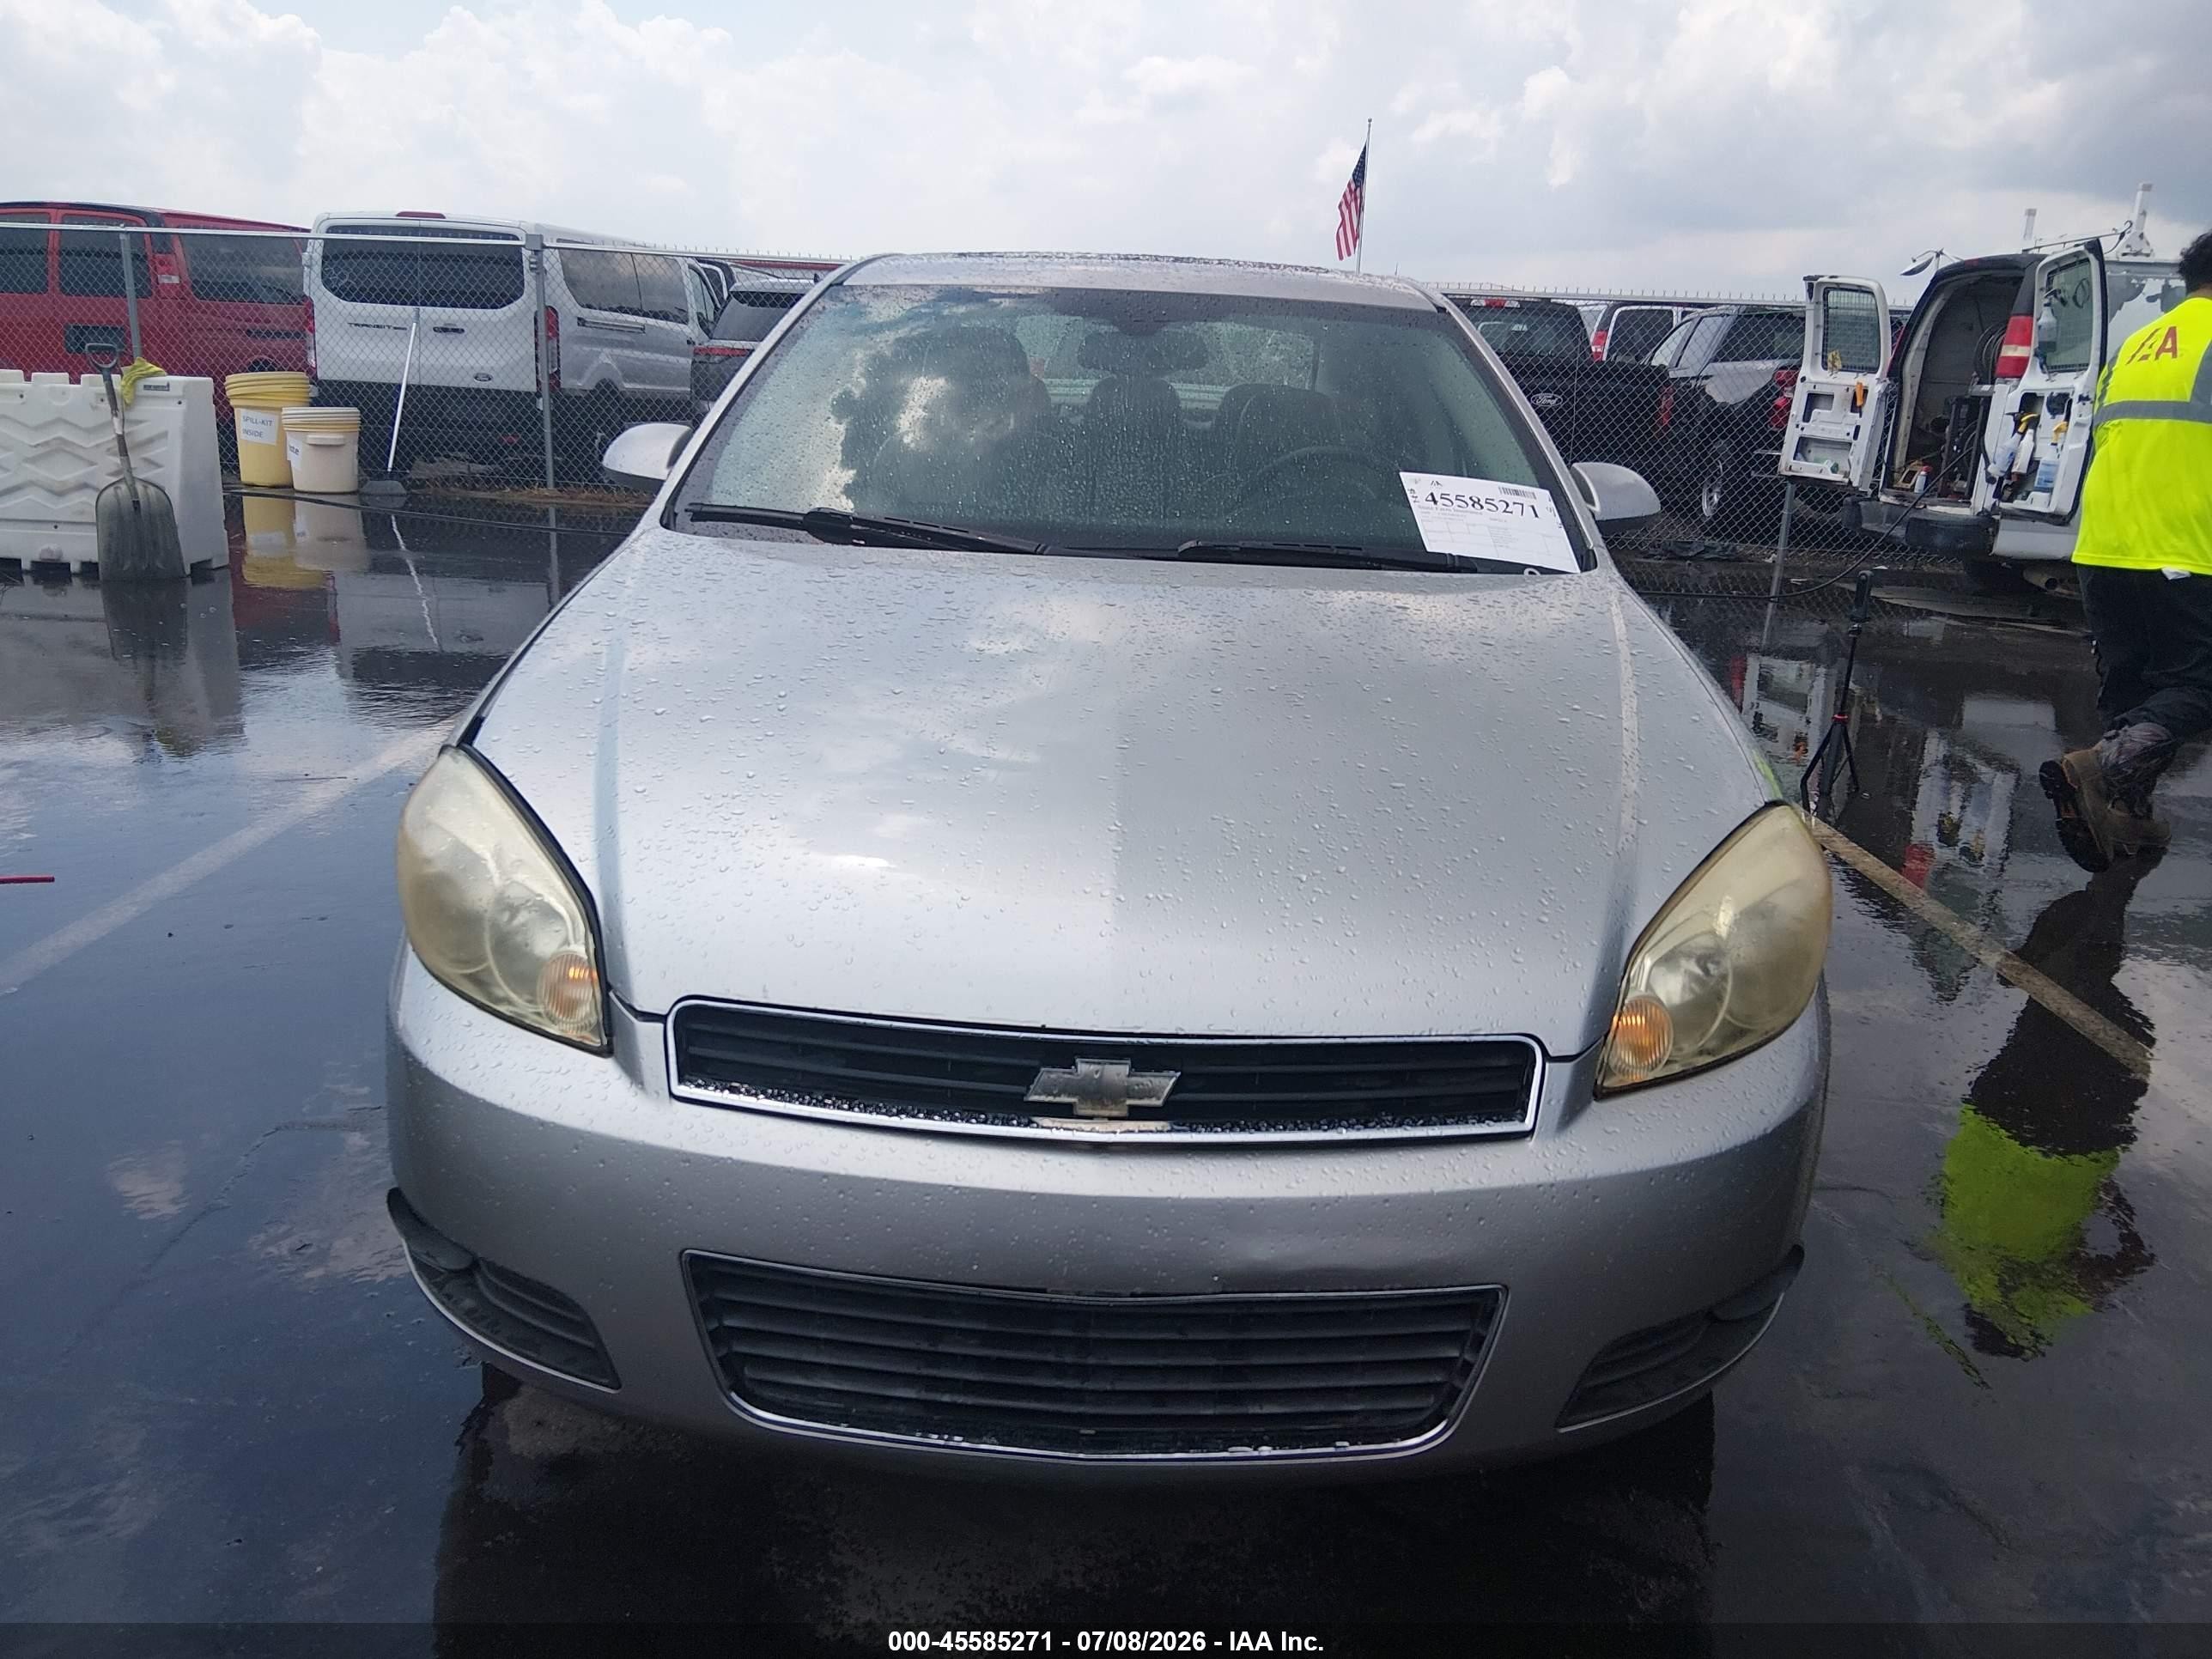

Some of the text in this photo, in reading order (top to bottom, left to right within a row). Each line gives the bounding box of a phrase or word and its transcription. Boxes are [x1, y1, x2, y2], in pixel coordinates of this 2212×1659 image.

[242, 415, 274, 427] SPILL-KIT
[242, 429, 264, 439] INSIDE
[1425, 491, 1540, 519] 45585271
